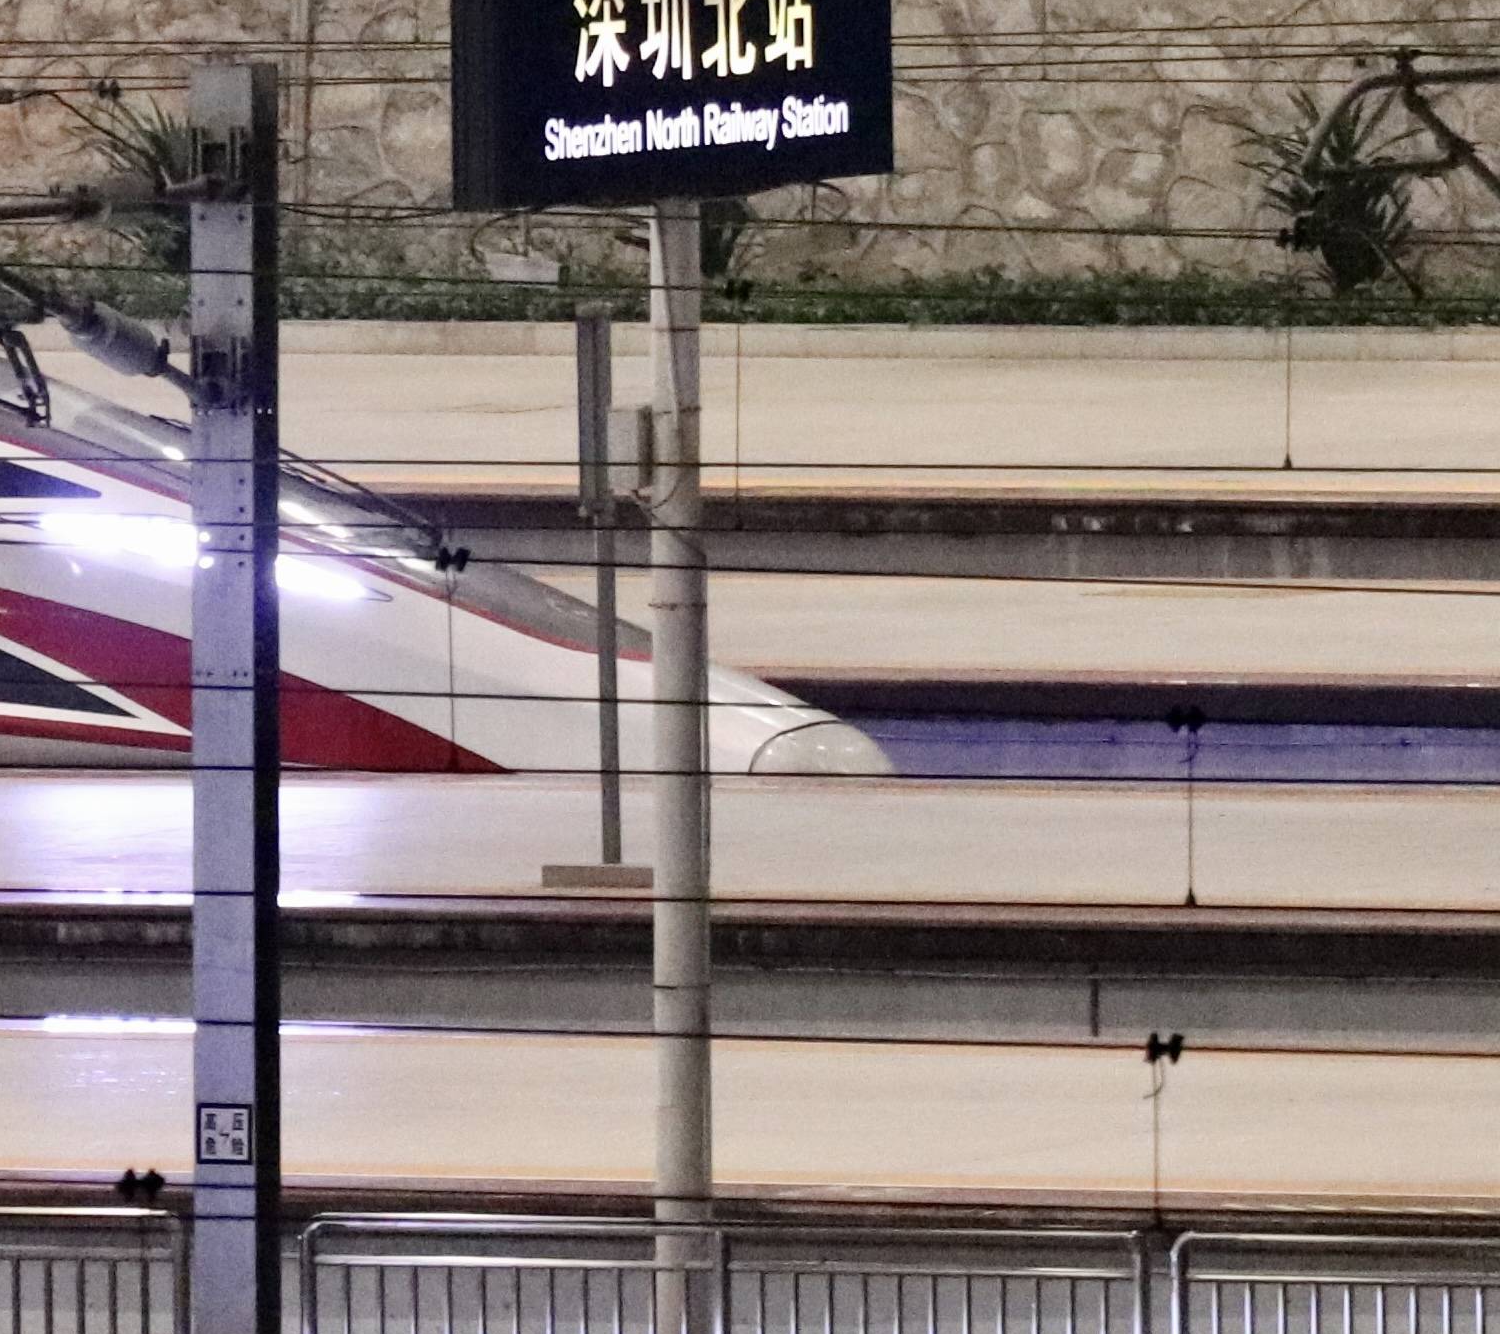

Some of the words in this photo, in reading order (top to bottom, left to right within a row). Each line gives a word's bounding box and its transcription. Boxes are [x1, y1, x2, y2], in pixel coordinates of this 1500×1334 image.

[544, 114, 642, 161] Shenzhen
[646, 106, 700, 151] North
[703, 102, 779, 150] Railway
[781, 94, 850, 139] Station
